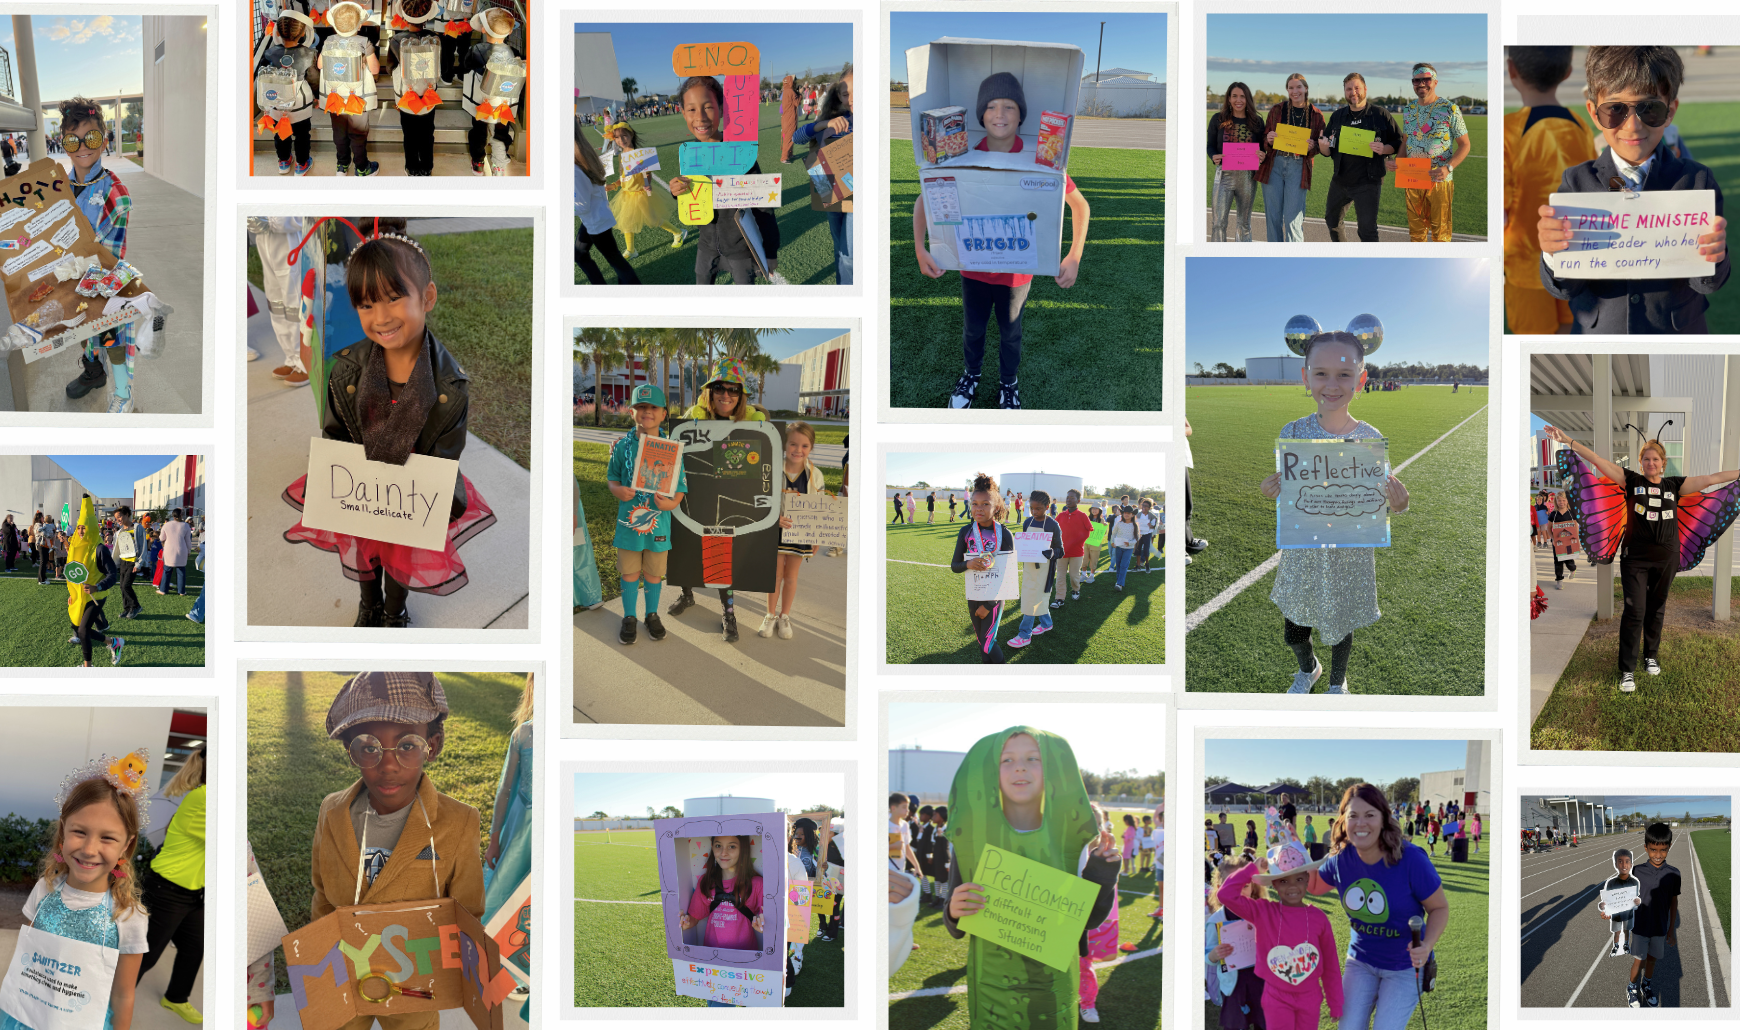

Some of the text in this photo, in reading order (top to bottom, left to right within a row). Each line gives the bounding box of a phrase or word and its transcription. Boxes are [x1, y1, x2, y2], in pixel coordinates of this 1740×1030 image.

[1023, 180, 1056, 188] Whirlpool
[1578, 213, 1631, 231] PRIME
[1635, 211, 1710, 229] MINISTER
[962, 237, 1031, 252] FRIGID
[1581, 237, 1599, 250] the
[1606, 235, 1648, 250] leader
[1655, 235, 1677, 248] who
[1560, 255, 1661, 270] run the country
[646, 440, 677, 453] FANATIC
[1284, 452, 1384, 481] Reflective
[331, 464, 439, 528] Dainty
[61, 511, 69, 524] GO
[372, 506, 414, 521] delicate
[796, 514, 818, 524] person
[1014, 532, 1053, 542] CREATIVE
[68, 566, 84, 579] GO
[979, 848, 1086, 918] Predicament
[985, 894, 1048, 925] a difficult or
[983, 907, 1047, 943] embarrassing
[32, 952, 81, 976] SANITIZER
[286, 923, 518, 1014] MYSTERY
[689, 963, 765, 983] Expressive
[52, 984, 61, 993] and
[61, 986, 85, 999] hygienic
[63, 982, 78, 990] make
[681, 977, 716, 995] effectively
[717, 983, 749, 999] conveying
